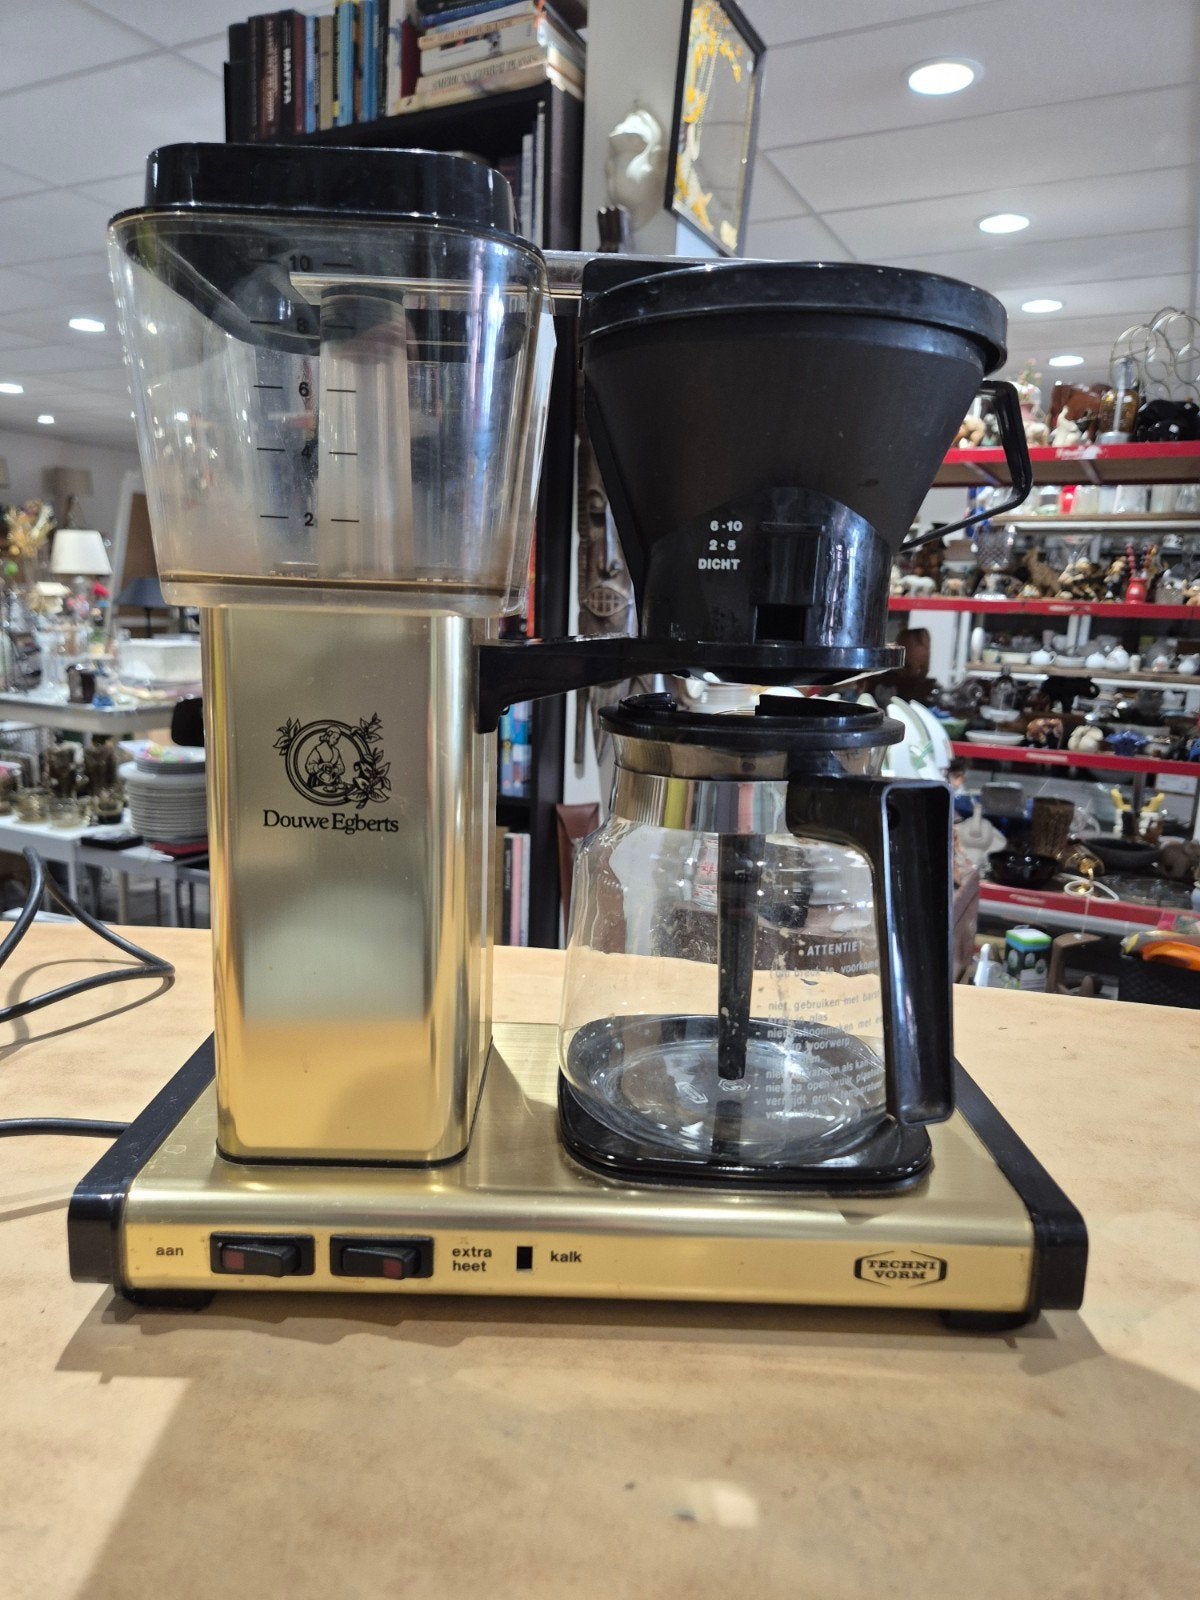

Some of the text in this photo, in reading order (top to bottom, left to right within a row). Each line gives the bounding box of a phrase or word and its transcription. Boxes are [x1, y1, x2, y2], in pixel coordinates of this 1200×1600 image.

[289, 255, 310, 271] 10
[297, 317, 308, 333] 8
[298, 382, 309, 397] 6
[301, 446, 312, 460] 4
[304, 513, 314, 527] 2
[698, 558, 741, 570] DICHT
[263, 809, 400, 835] Douwe Egberts
[794, 997, 840, 1012] gebruiken
[810, 1013, 829, 1025] glas
[808, 1037, 850, 1051] voorwerp
[807, 1080, 830, 1092] open
[155, 1245, 184, 1257] aan
[452, 1245, 493, 1259] extra
[550, 1250, 583, 1263] kalk
[452, 1260, 488, 1272] heet
[867, 1259, 937, 1270] TECHNI
[874, 1270, 926, 1279] VORM
